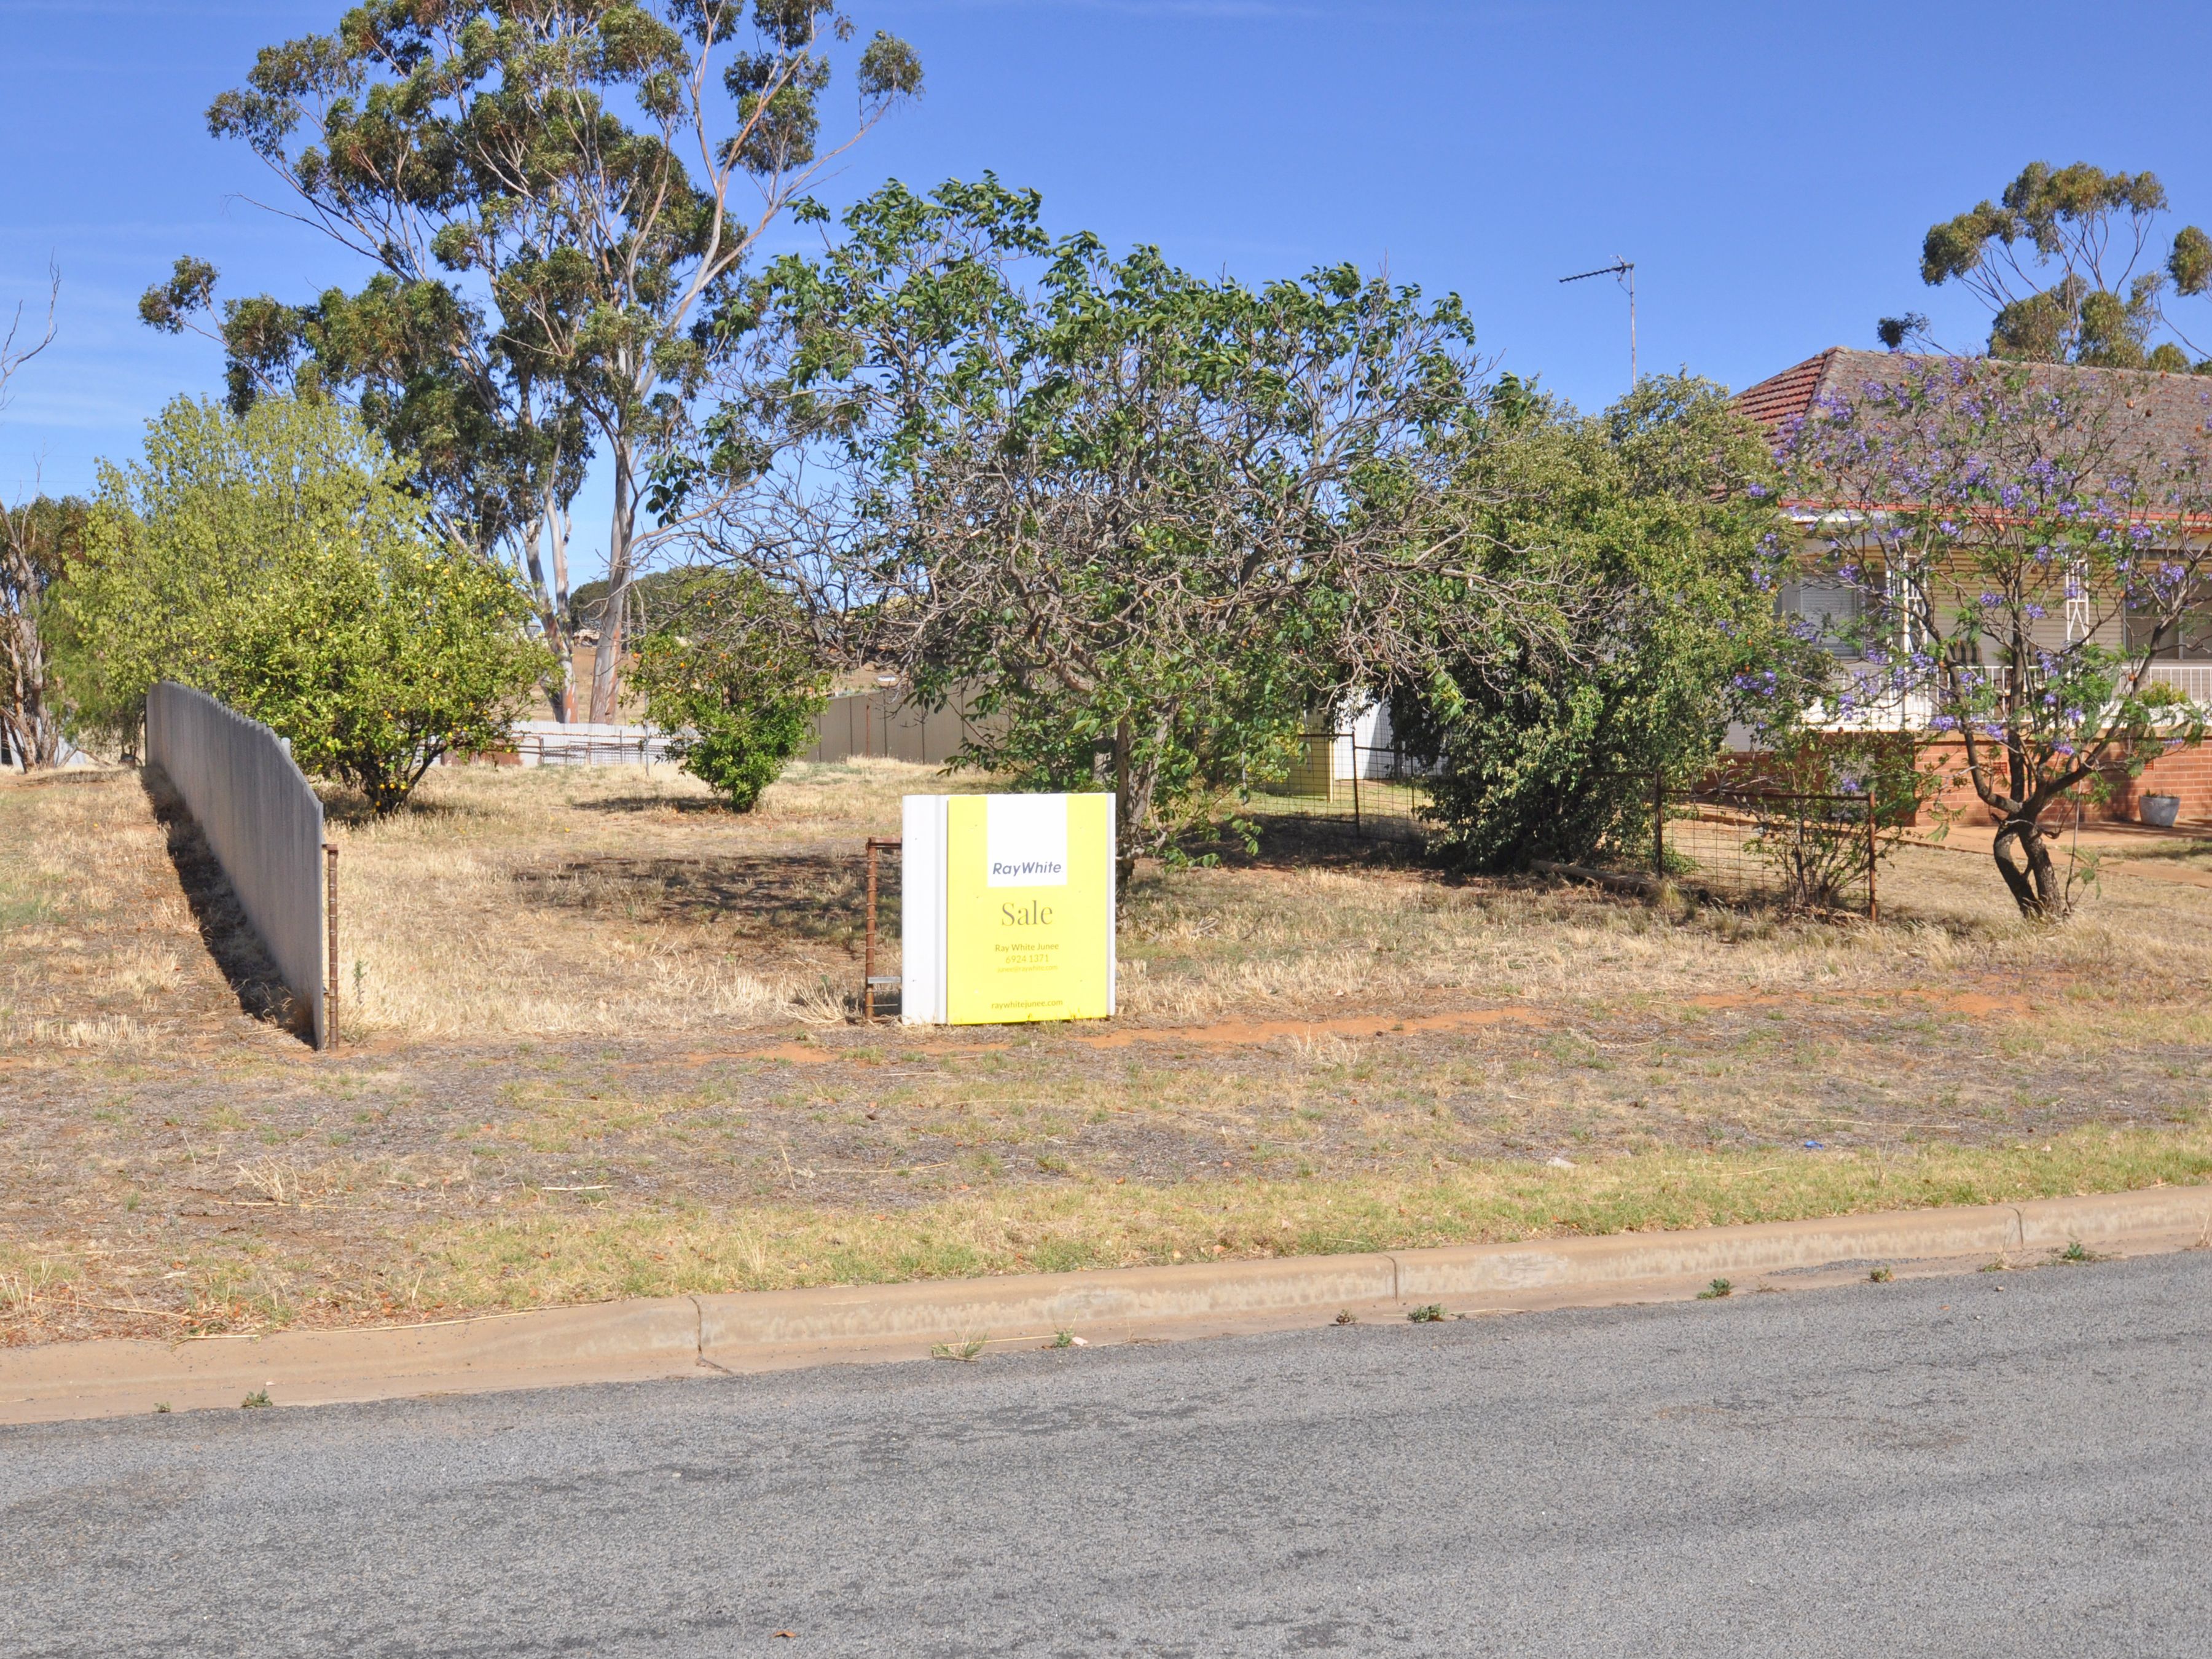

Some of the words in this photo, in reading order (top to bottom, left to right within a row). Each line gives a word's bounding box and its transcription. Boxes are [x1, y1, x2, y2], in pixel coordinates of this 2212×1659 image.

[1002, 900, 1053, 926] Sale
[995, 944, 1010, 953] Ray
[1005, 955, 1027, 964] 6924
[1030, 954, 1049, 963] 1371
[991, 1000, 1063, 1010] raywhitejunee.com
